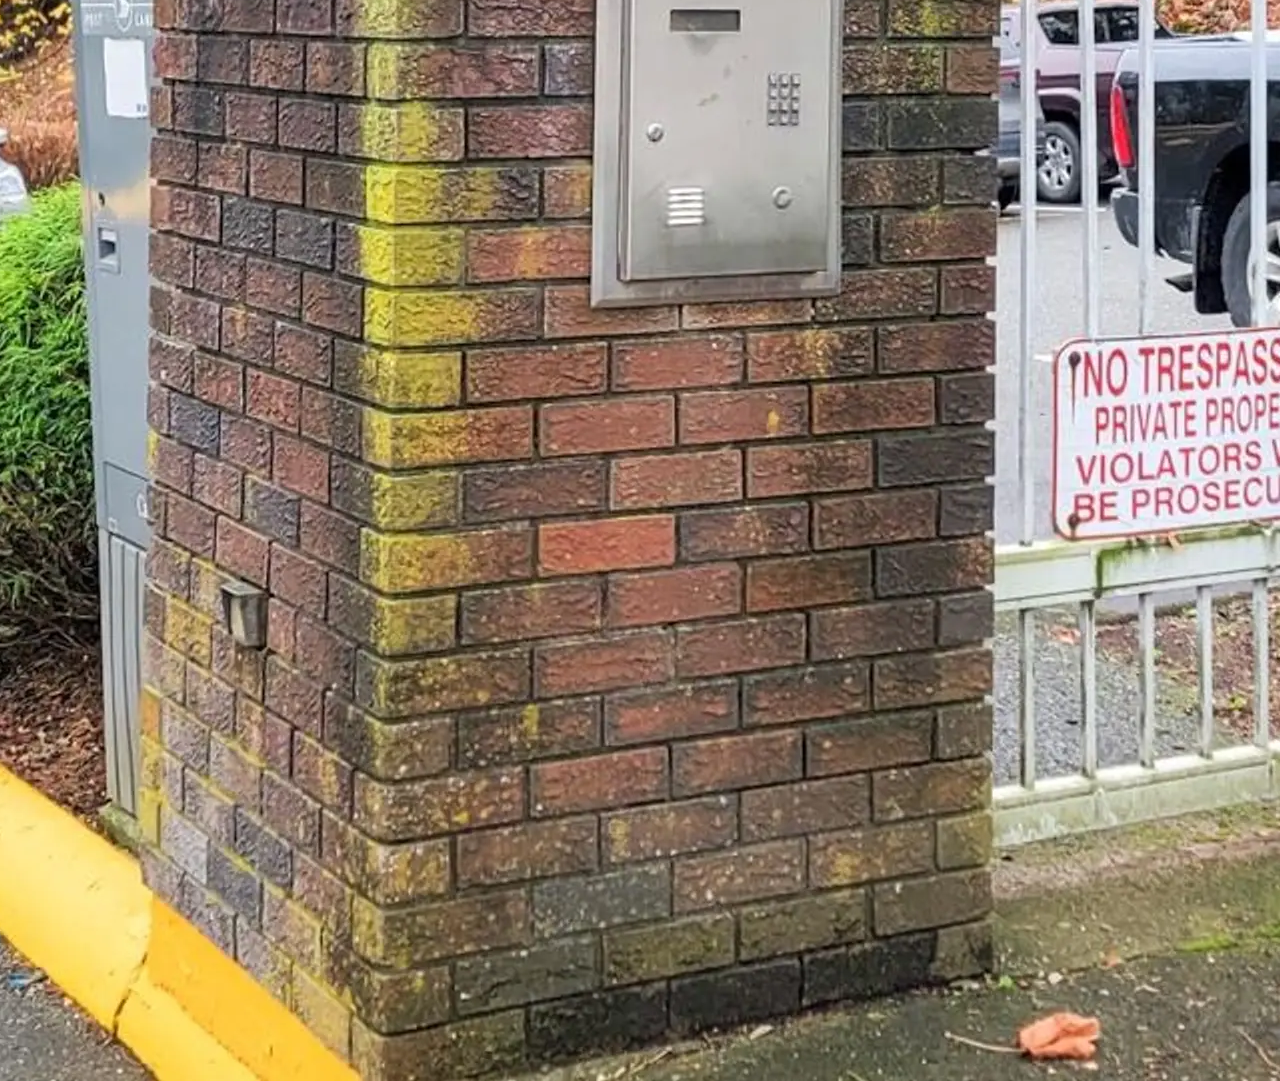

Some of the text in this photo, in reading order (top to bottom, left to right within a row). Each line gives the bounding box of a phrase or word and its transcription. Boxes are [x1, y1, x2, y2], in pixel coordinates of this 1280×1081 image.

[1083, 348, 1128, 397] NO
[1095, 400, 1197, 445] PRIVATE
[1076, 440, 1262, 486] VIOLATORS
[1073, 491, 1119, 522] BE
